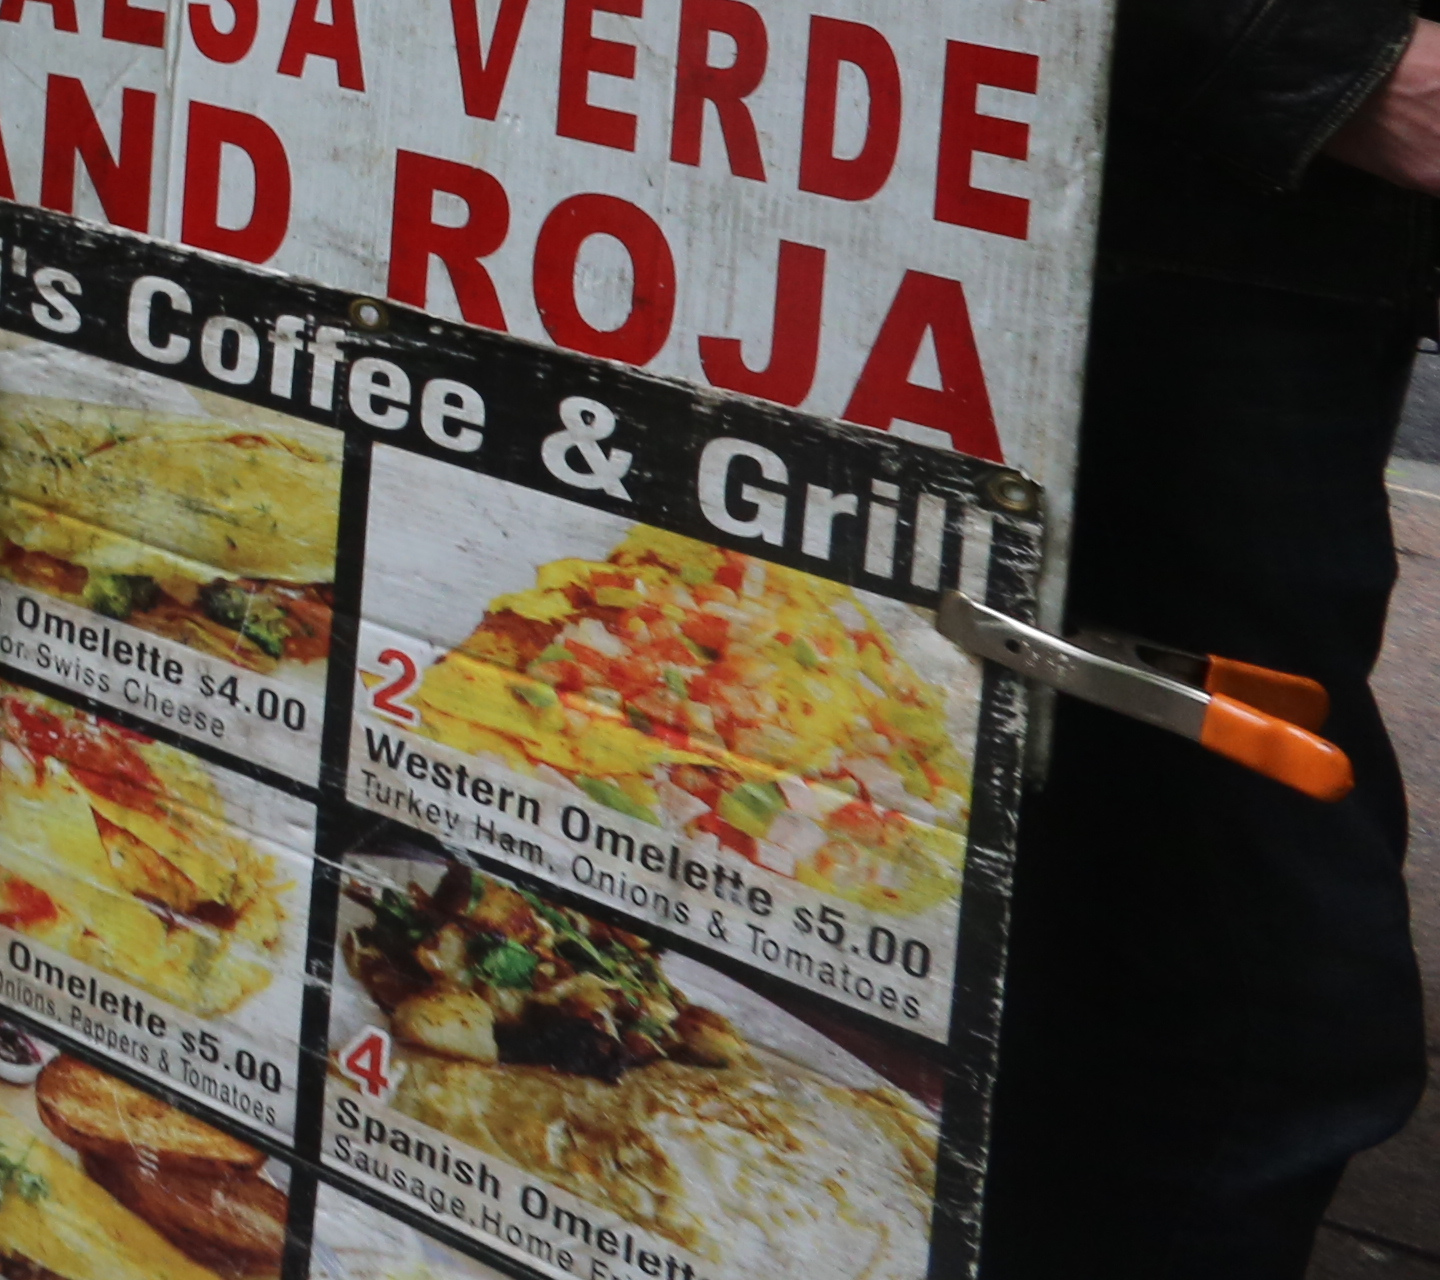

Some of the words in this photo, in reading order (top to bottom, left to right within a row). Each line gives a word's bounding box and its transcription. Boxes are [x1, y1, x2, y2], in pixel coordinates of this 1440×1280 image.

[385, 145, 1006, 467] ROJA
[126, 274, 485, 454] Coffee
[539, 394, 637, 503] &
[697, 436, 993, 605] Grill
[373, 648, 418, 722] 2
[361, 769, 461, 833] Turkey
[571, 855, 690, 924] Onions
[707, 908, 728, 941] &
[747, 921, 922, 1022] Tomatoes
[364, 724, 541, 827] Western
[561, 803, 772, 918] Omelette
[793, 899, 931, 979] $5.00
